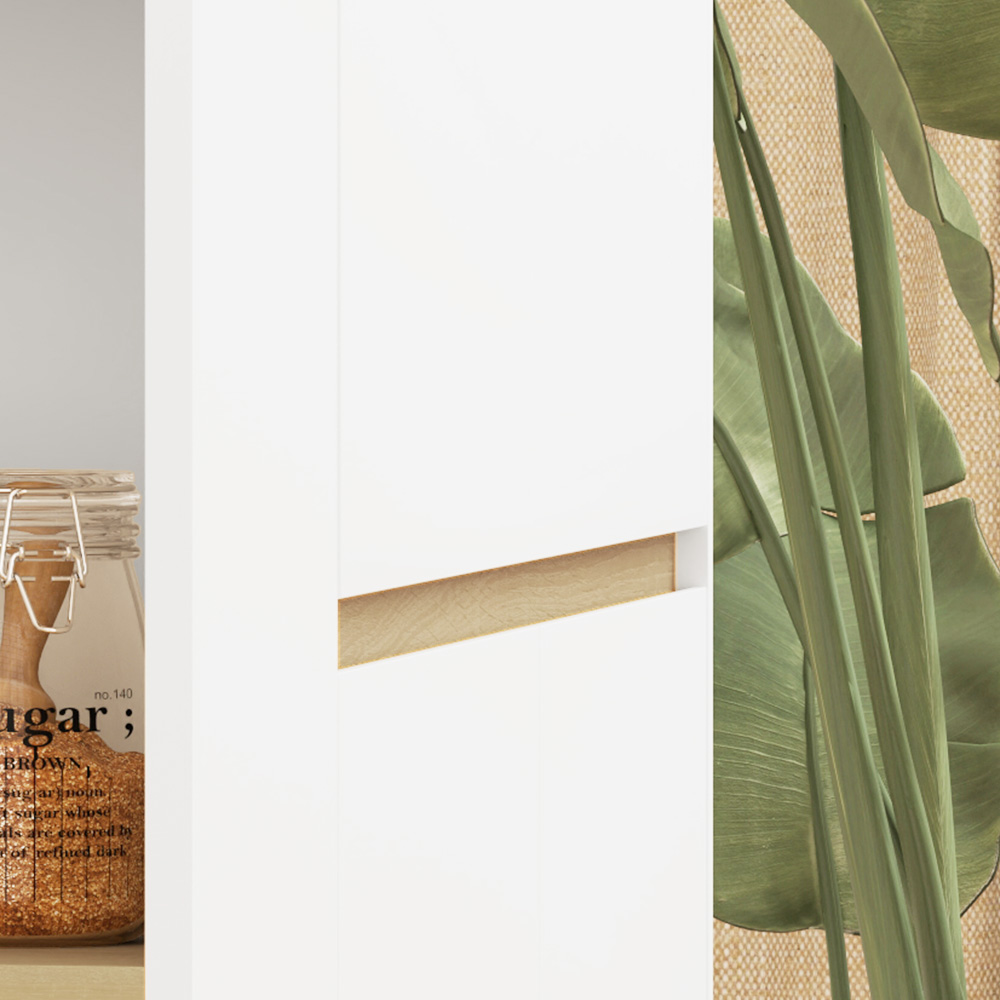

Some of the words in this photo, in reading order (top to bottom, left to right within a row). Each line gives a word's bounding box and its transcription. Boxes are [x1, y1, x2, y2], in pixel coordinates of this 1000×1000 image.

[94, 688, 133, 700] no.140
[124, 708, 134, 739] ;
[66, 788, 106, 798] noun.
[14, 809, 59, 821] sugar
[65, 806, 110, 818] whose
[28, 829, 52, 838] are
[58, 825, 114, 838] covered
[120, 824, 133, 840] by
[11, 847, 27, 858] of
[37, 846, 91, 858] refined
[97, 845, 127, 857] dark
